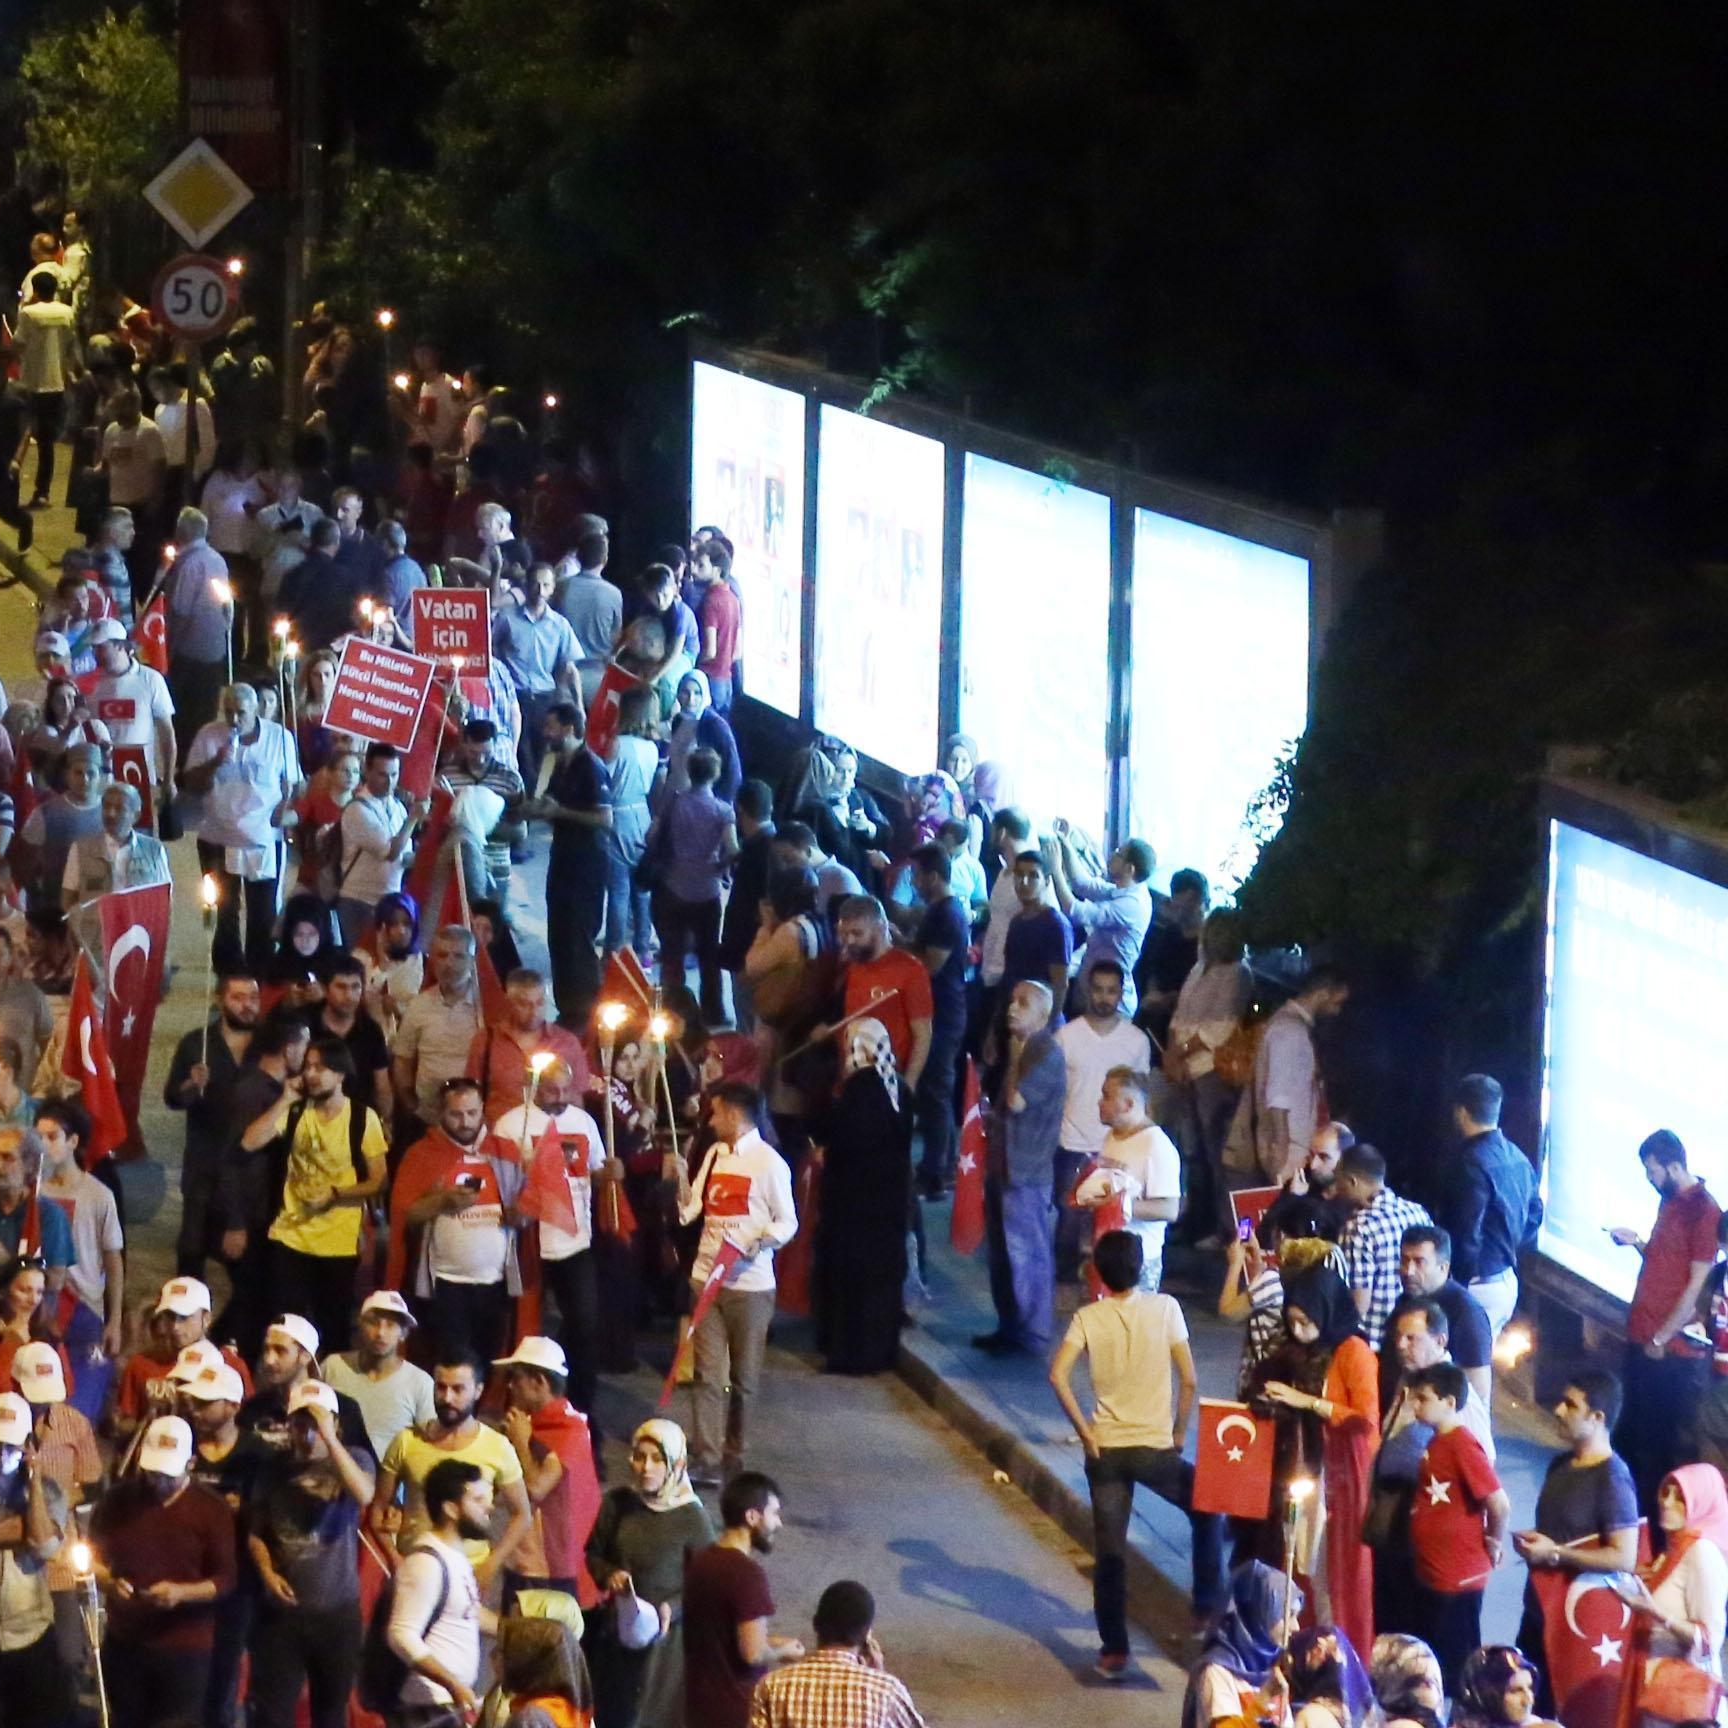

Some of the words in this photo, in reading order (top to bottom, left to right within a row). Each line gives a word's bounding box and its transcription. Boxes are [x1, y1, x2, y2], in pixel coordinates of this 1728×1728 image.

[171, 277, 223, 319] 50
[418, 597, 477, 620] Vatan
[432, 624, 468, 651] için
[359, 649, 375, 664] Bu
[374, 654, 414, 677] Milletin
[338, 683, 366, 702] Nene
[365, 691, 414, 717] Hatunları
[351, 707, 392, 731] Bitmez!
